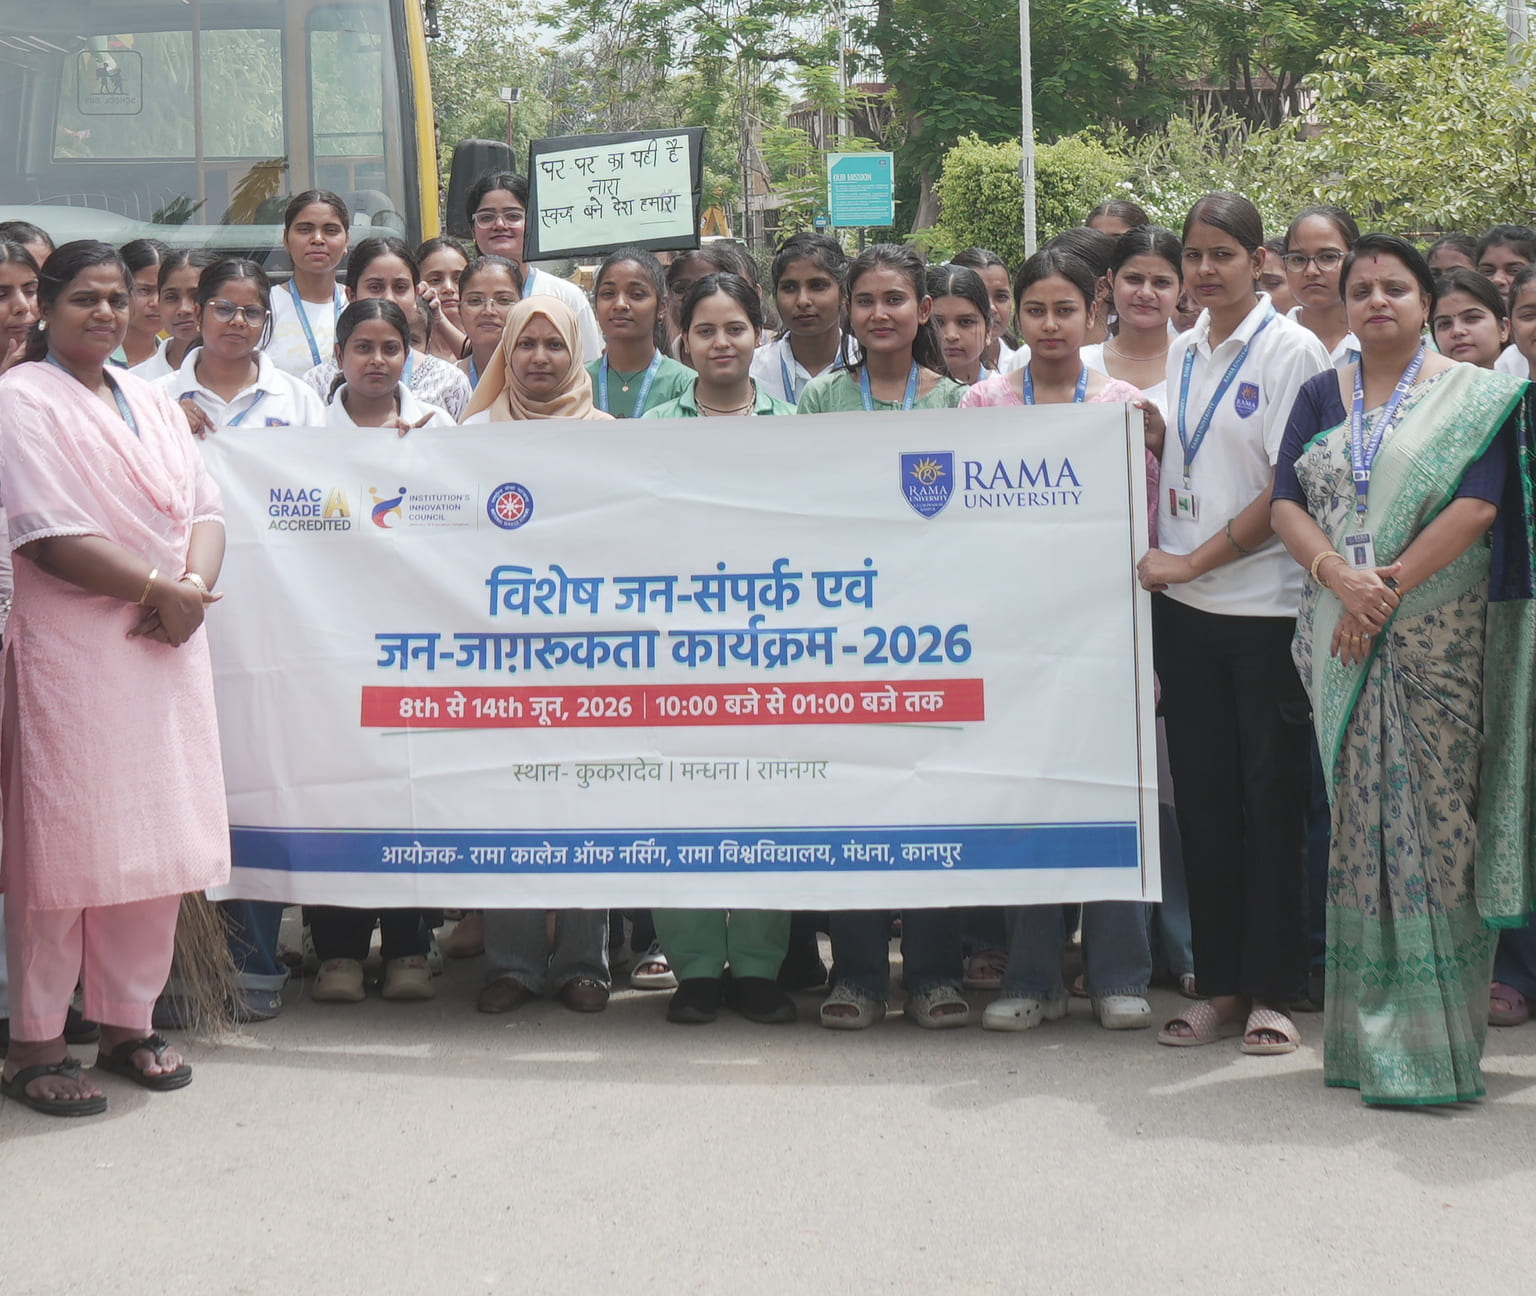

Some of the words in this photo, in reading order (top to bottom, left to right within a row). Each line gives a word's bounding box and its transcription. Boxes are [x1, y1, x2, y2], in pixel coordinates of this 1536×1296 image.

[587, 177, 621, 195] नारा
[962, 457, 1083, 491] RAMA
[909, 485, 948, 497] RAMA
[964, 490, 1082, 509] UNIVERSITY
[268, 504, 321, 517] GRADE
[269, 488, 322, 503] NAAC
[323, 487, 352, 518] A
[409, 503, 461, 511] INNOVATION
[268, 519, 351, 532] ACCREDITED
[408, 513, 446, 521] COUNCIL
[485, 564, 605, 616] विशेष
[613, 558, 803, 614] जन-संपर्क
[812, 557, 878, 609] एवं
[399, 697, 439, 718] 8th
[446, 691, 467, 718] से
[472, 697, 523, 718] 14th
[529, 696, 569, 726] जून,
[576, 696, 633, 717] 2026
[656, 694, 718, 716] 10:00
[723, 687, 761, 716] बजे
[765, 687, 786, 715] से
[792, 693, 855, 714] 01:00
[861, 685, 898, 713] बजे
[903, 690, 945, 712] तक
[574, 757, 664, 789] कुकरादेव
[680, 761, 740, 781] मन्धना
[757, 760, 829, 780] रामनगर
[381, 840, 464, 864] आयोजक-
[469, 846, 506, 865] रामा
[510, 840, 568, 865] कालेज
[573, 840, 614, 865] ऑफ
[677, 845, 714, 864] रामा
[718, 839, 836, 865] विश्वविद्यालय,
[842, 839, 895, 865] मंधना,
[901, 842, 963, 868] कानपुर
